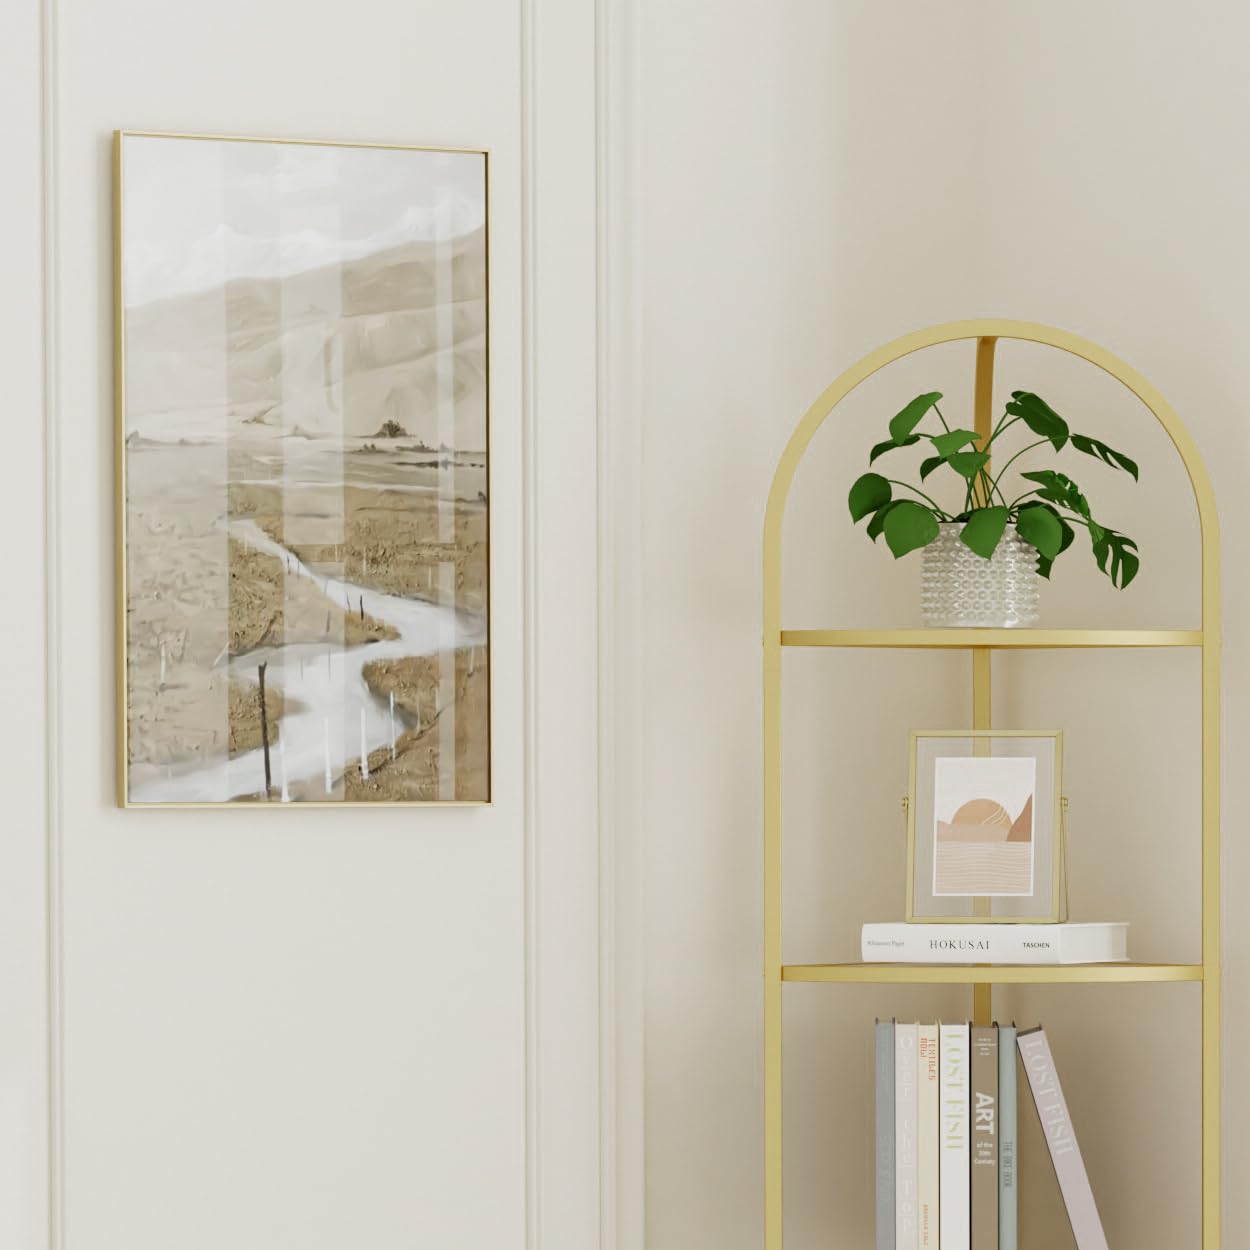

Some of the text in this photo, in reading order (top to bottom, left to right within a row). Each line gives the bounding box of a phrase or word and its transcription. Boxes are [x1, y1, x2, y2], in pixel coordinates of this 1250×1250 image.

[929, 939, 991, 951] HOKUSAI
[1023, 941, 1050, 949] TASCHEN
[945, 1033, 964, 1091] LOST
[1024, 1038, 1060, 1099] LOST
[976, 1091, 994, 1135] ART
